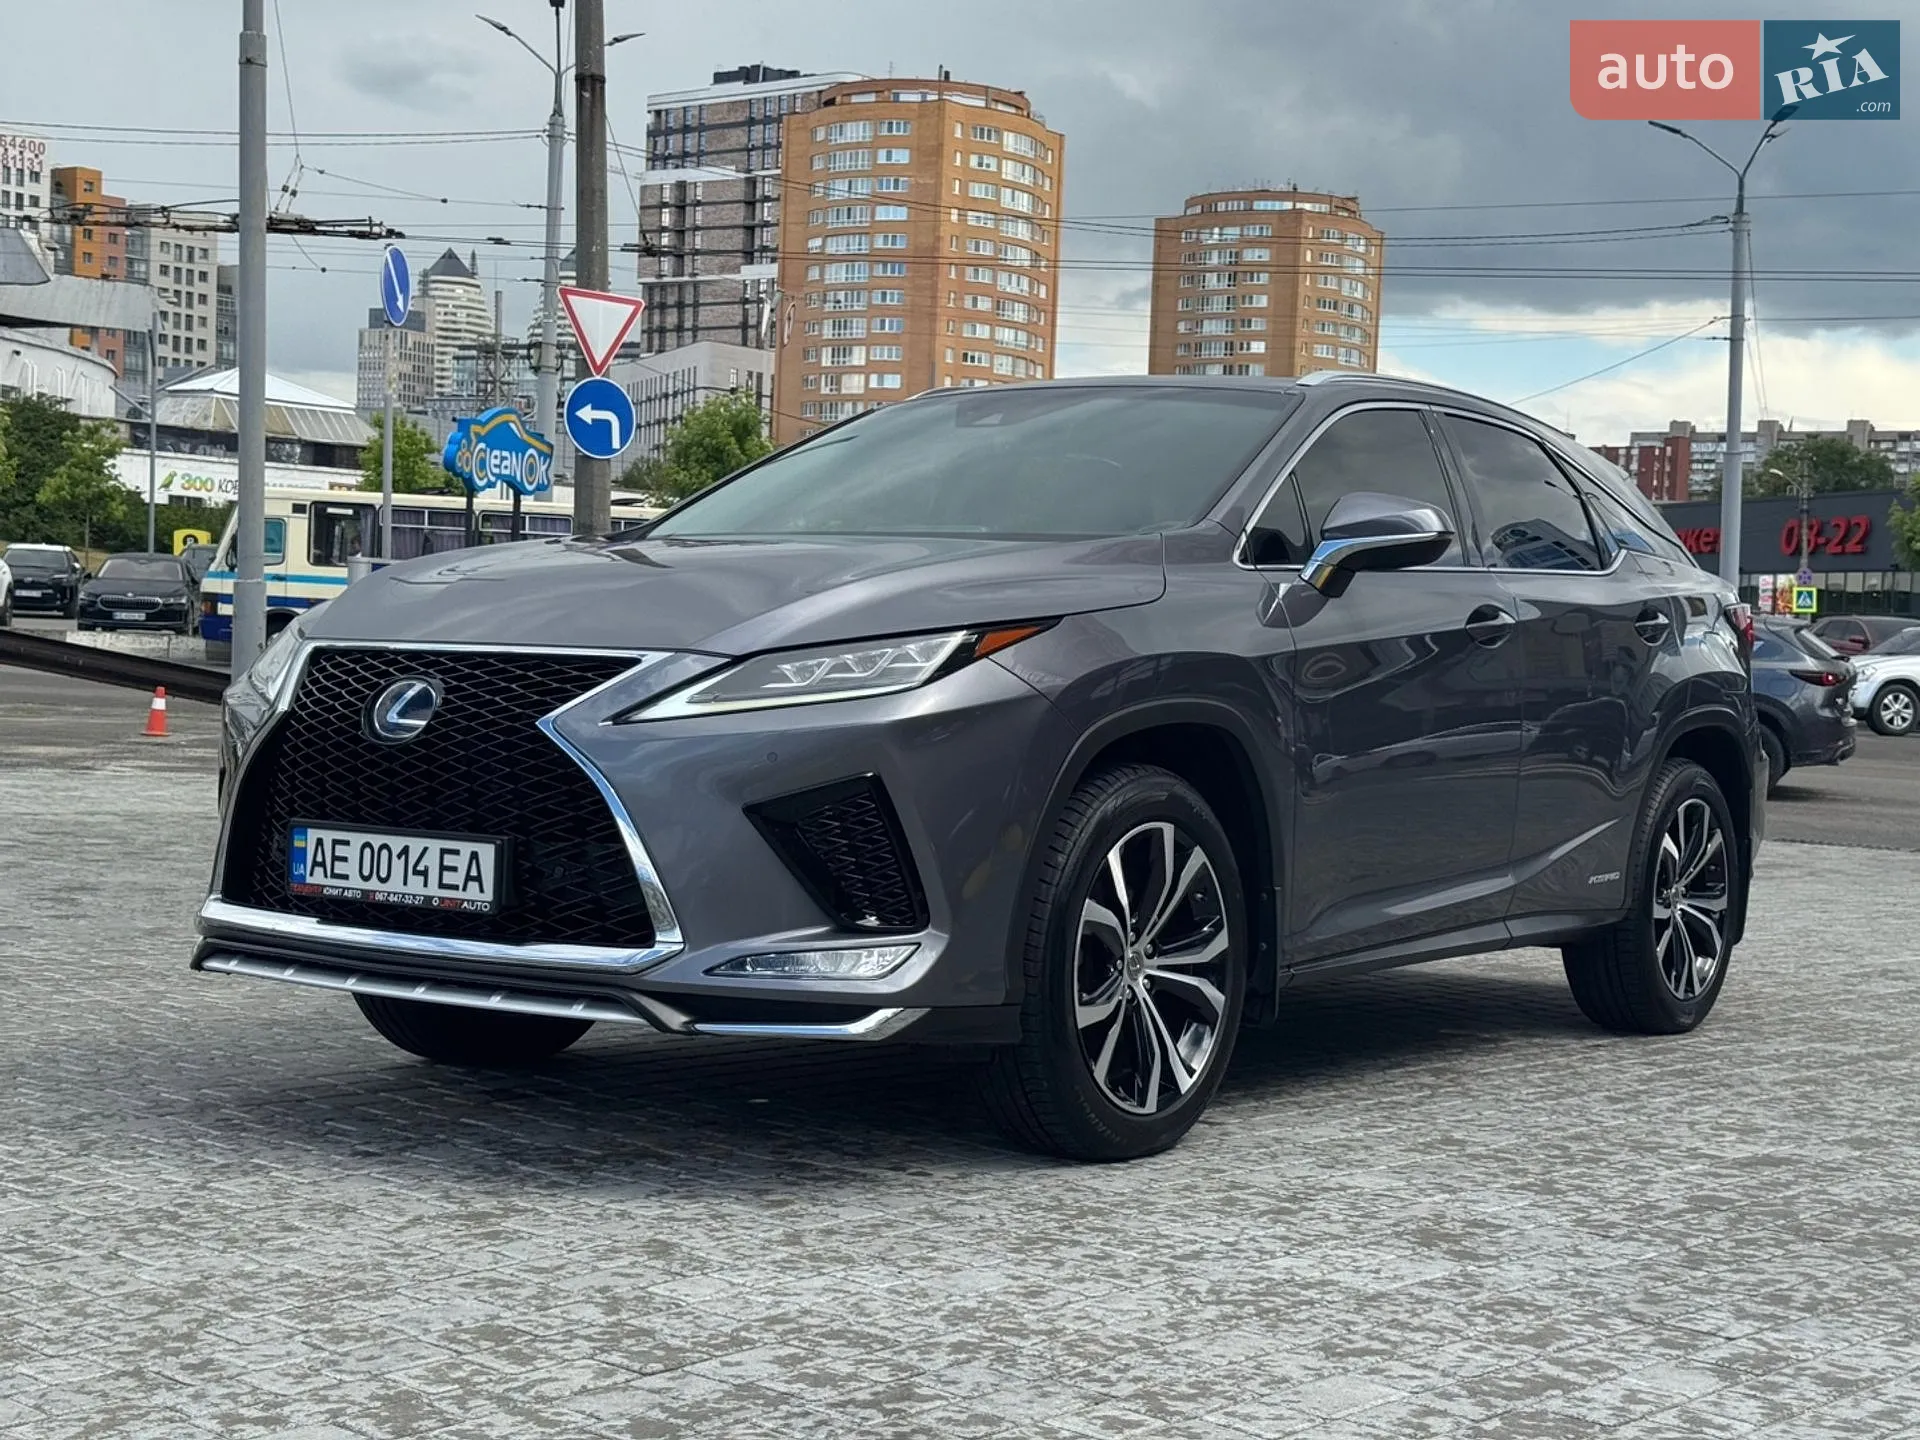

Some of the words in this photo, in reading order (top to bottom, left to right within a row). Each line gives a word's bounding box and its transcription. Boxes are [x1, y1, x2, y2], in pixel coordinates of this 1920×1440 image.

[181, 472, 215, 492] 300
[292, 862, 305, 876] UA
[309, 837, 350, 881] AE
[358, 841, 430, 888] 0014
[438, 847, 485, 894] EA
